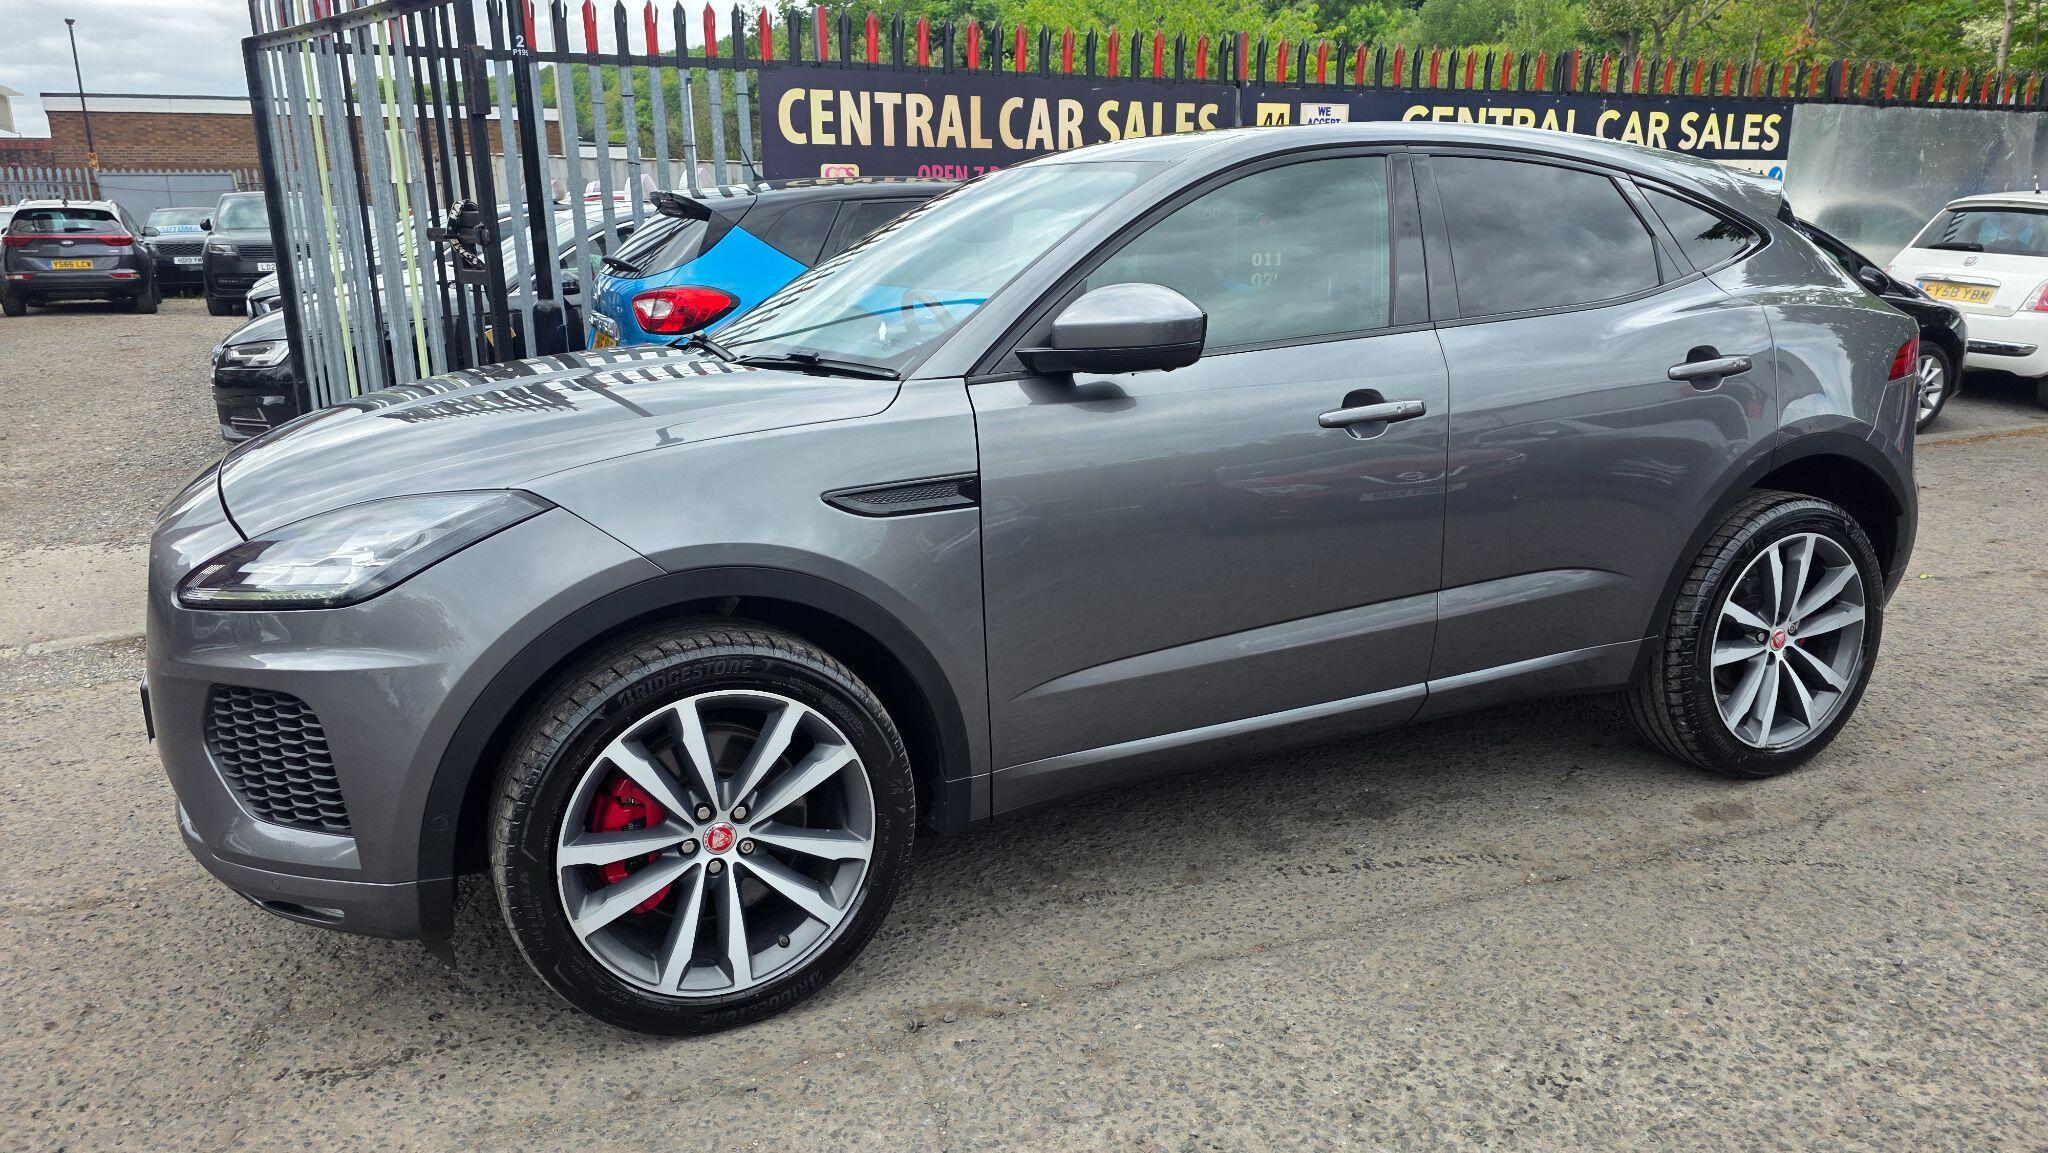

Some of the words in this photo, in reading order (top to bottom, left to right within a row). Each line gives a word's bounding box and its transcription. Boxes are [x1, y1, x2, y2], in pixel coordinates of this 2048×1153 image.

[515, 34, 525, 48] 2
[778, 87, 993, 149] CENTRAL
[999, 96, 1084, 151] CAR
[1263, 112, 1285, 126] AA
[1317, 106, 1332, 117] WE
[1595, 109, 1670, 149] CAR
[1677, 111, 1782, 152] SALES
[917, 164, 969, 180] OPEN
[76, 260, 92, 269] LCW
[617, 656, 753, 707] BRIDGESTONE
